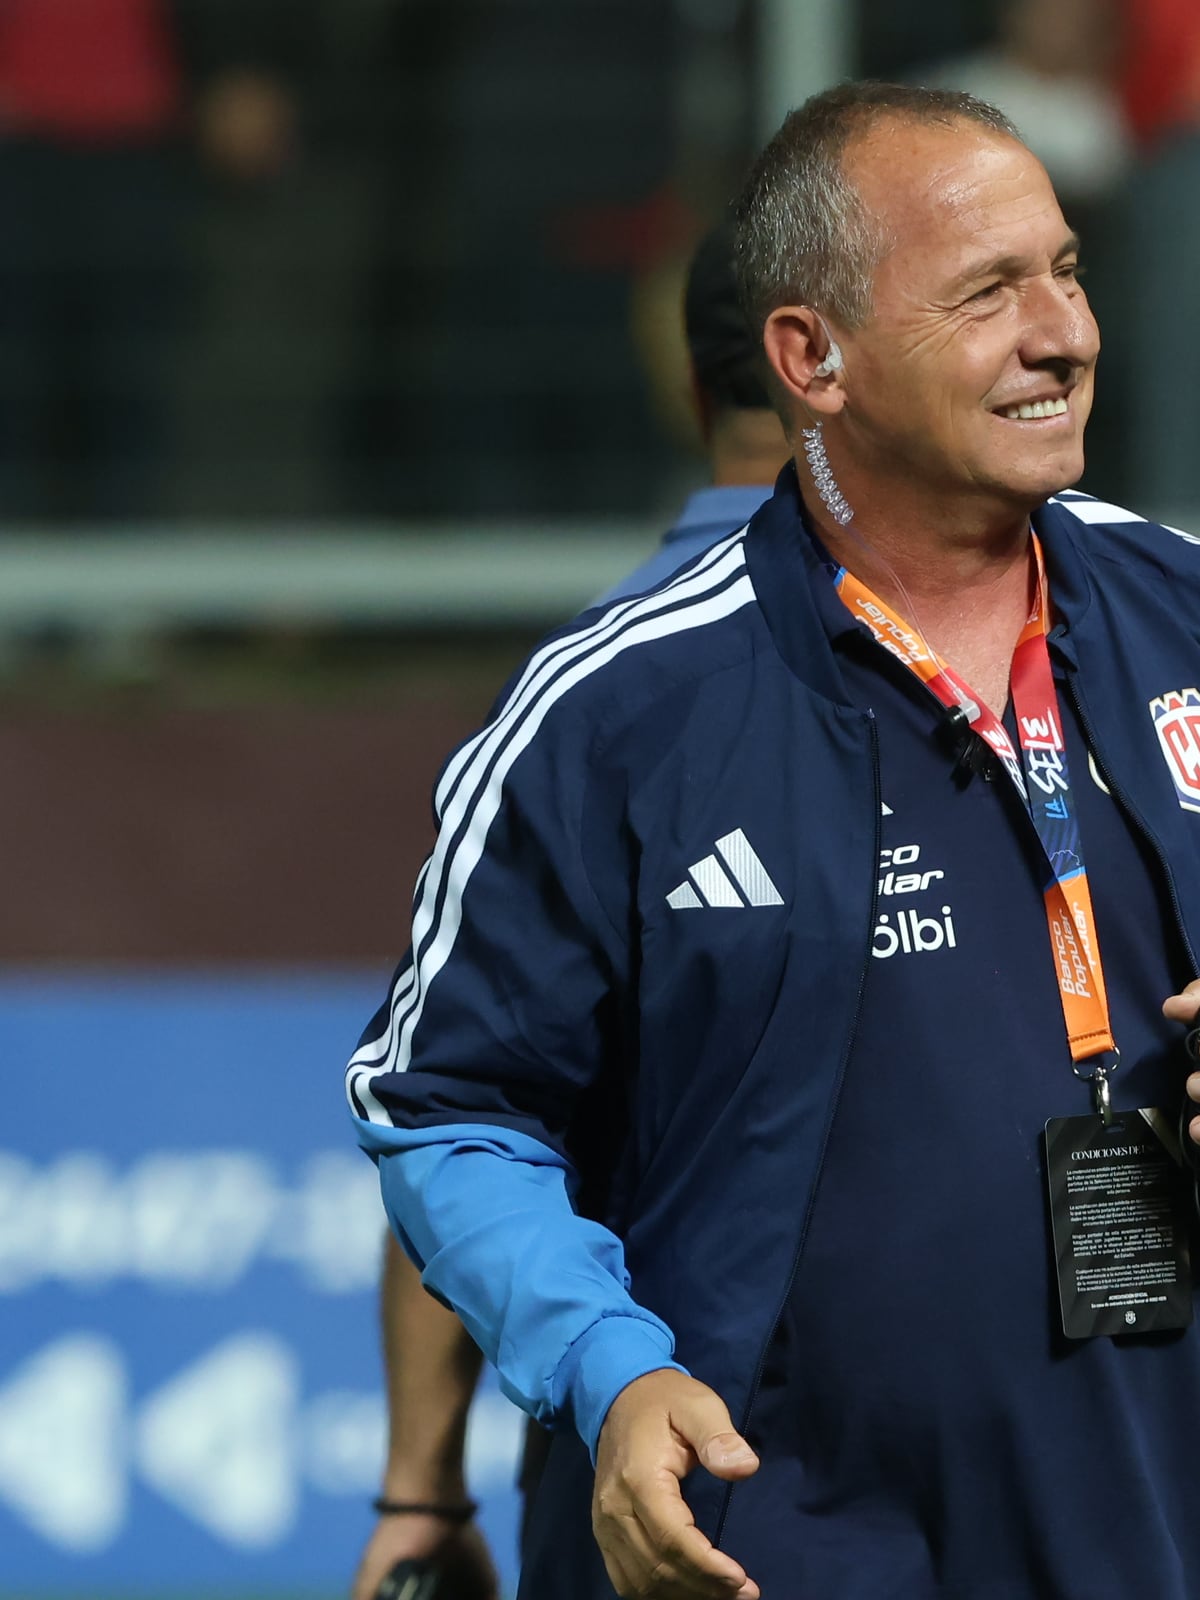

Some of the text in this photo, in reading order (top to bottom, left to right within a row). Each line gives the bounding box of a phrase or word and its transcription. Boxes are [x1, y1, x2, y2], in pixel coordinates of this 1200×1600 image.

[855, 598, 929, 662] Popular
[1020, 706, 1069, 819] LA SELE
[1052, 920, 1076, 996] Banco
[1058, 908, 1092, 999] Popular
[1070, 1145, 1129, 1161] CONDICIONES
